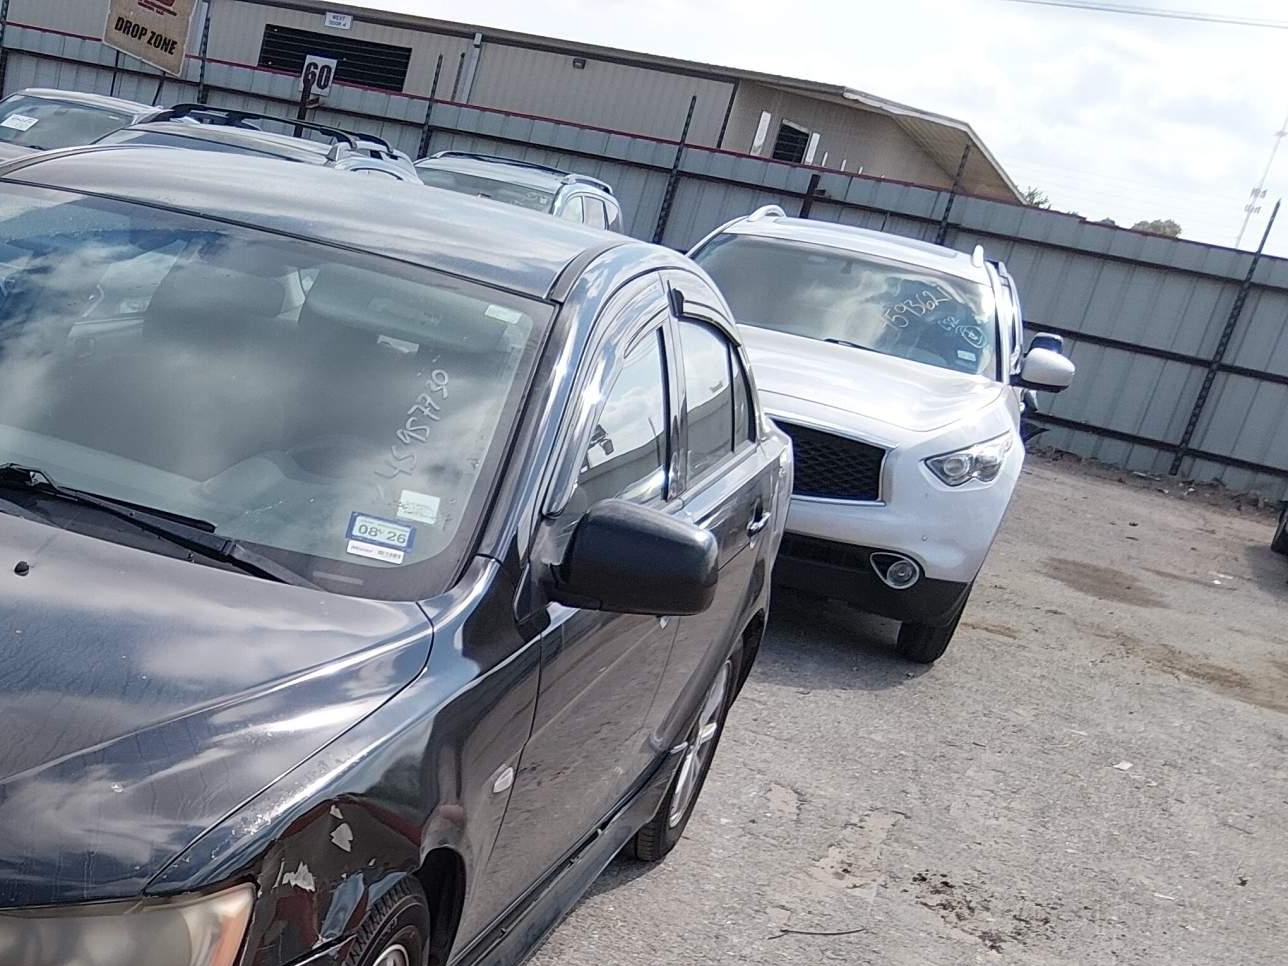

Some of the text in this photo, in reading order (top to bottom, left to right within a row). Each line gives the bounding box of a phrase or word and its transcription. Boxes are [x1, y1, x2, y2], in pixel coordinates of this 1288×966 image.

[114, 16, 178, 55] DROP ZONE
[302, 62, 333, 90] 60
[373, 369, 449, 479] 45957730
